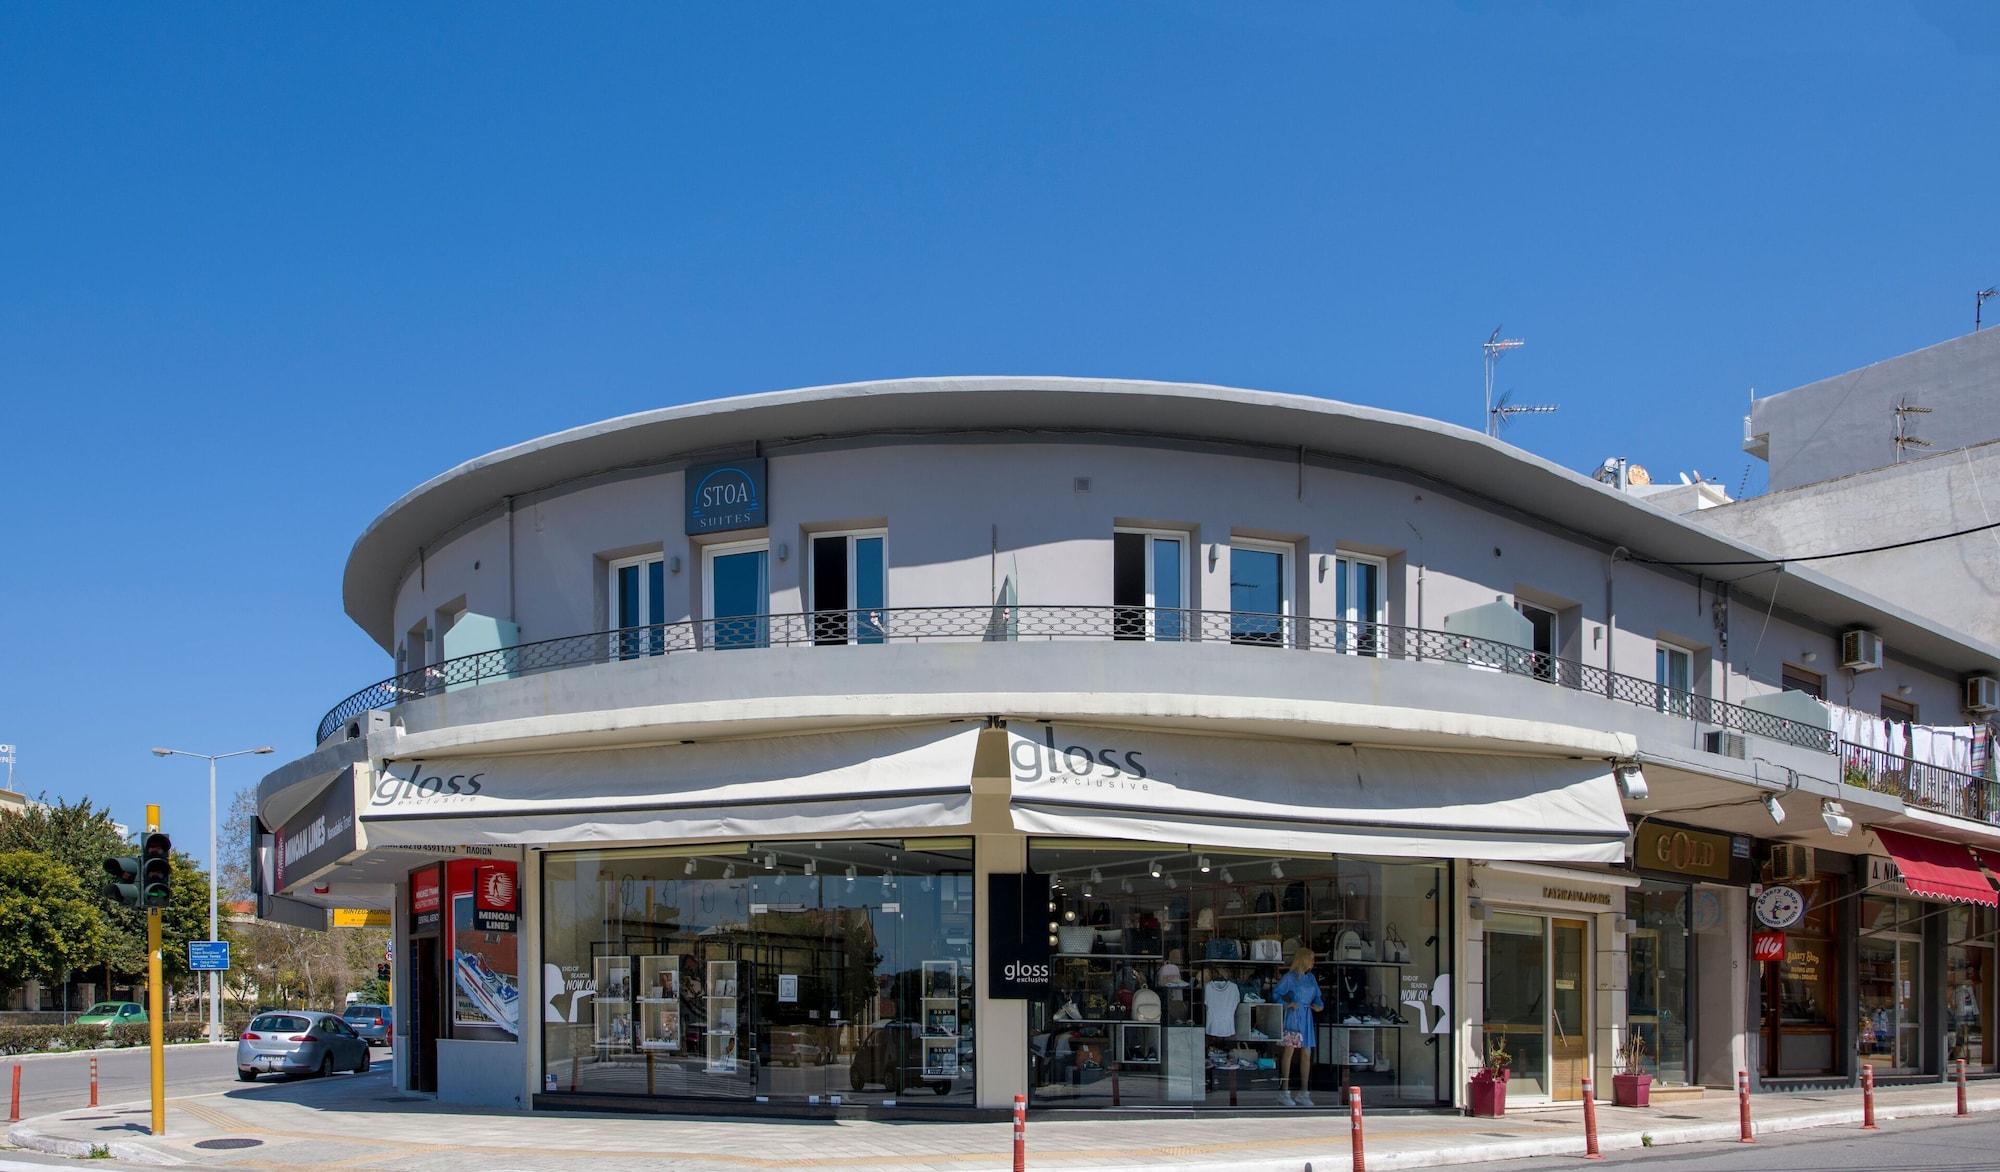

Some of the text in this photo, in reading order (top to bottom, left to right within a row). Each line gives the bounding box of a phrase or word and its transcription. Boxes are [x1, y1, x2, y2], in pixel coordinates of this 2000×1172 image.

[703, 482, 748, 507] STOA
[700, 513, 751, 528] SUITES
[1010, 726, 1147, 782] gloss
[371, 764, 485, 806] gloss
[1049, 777, 1149, 791] exclusive
[284, 826, 307, 868] MINOAN
[308, 815, 326, 854] LINES
[466, 846, 492, 856] ΠΛΟΙΩΝ
[1657, 831, 1715, 870] GOLD
[1760, 887, 1782, 905] Bakery
[1783, 889, 1798, 905] Shop
[479, 911, 515, 921] MINOAN
[486, 921, 510, 930] LINES
[1755, 937, 1782, 958] illy
[1787, 951, 1806, 963] Bakery
[1004, 960, 1049, 980] gloss
[566, 980, 584, 991] NOW
[1401, 990, 1428, 1000] NOW ON
